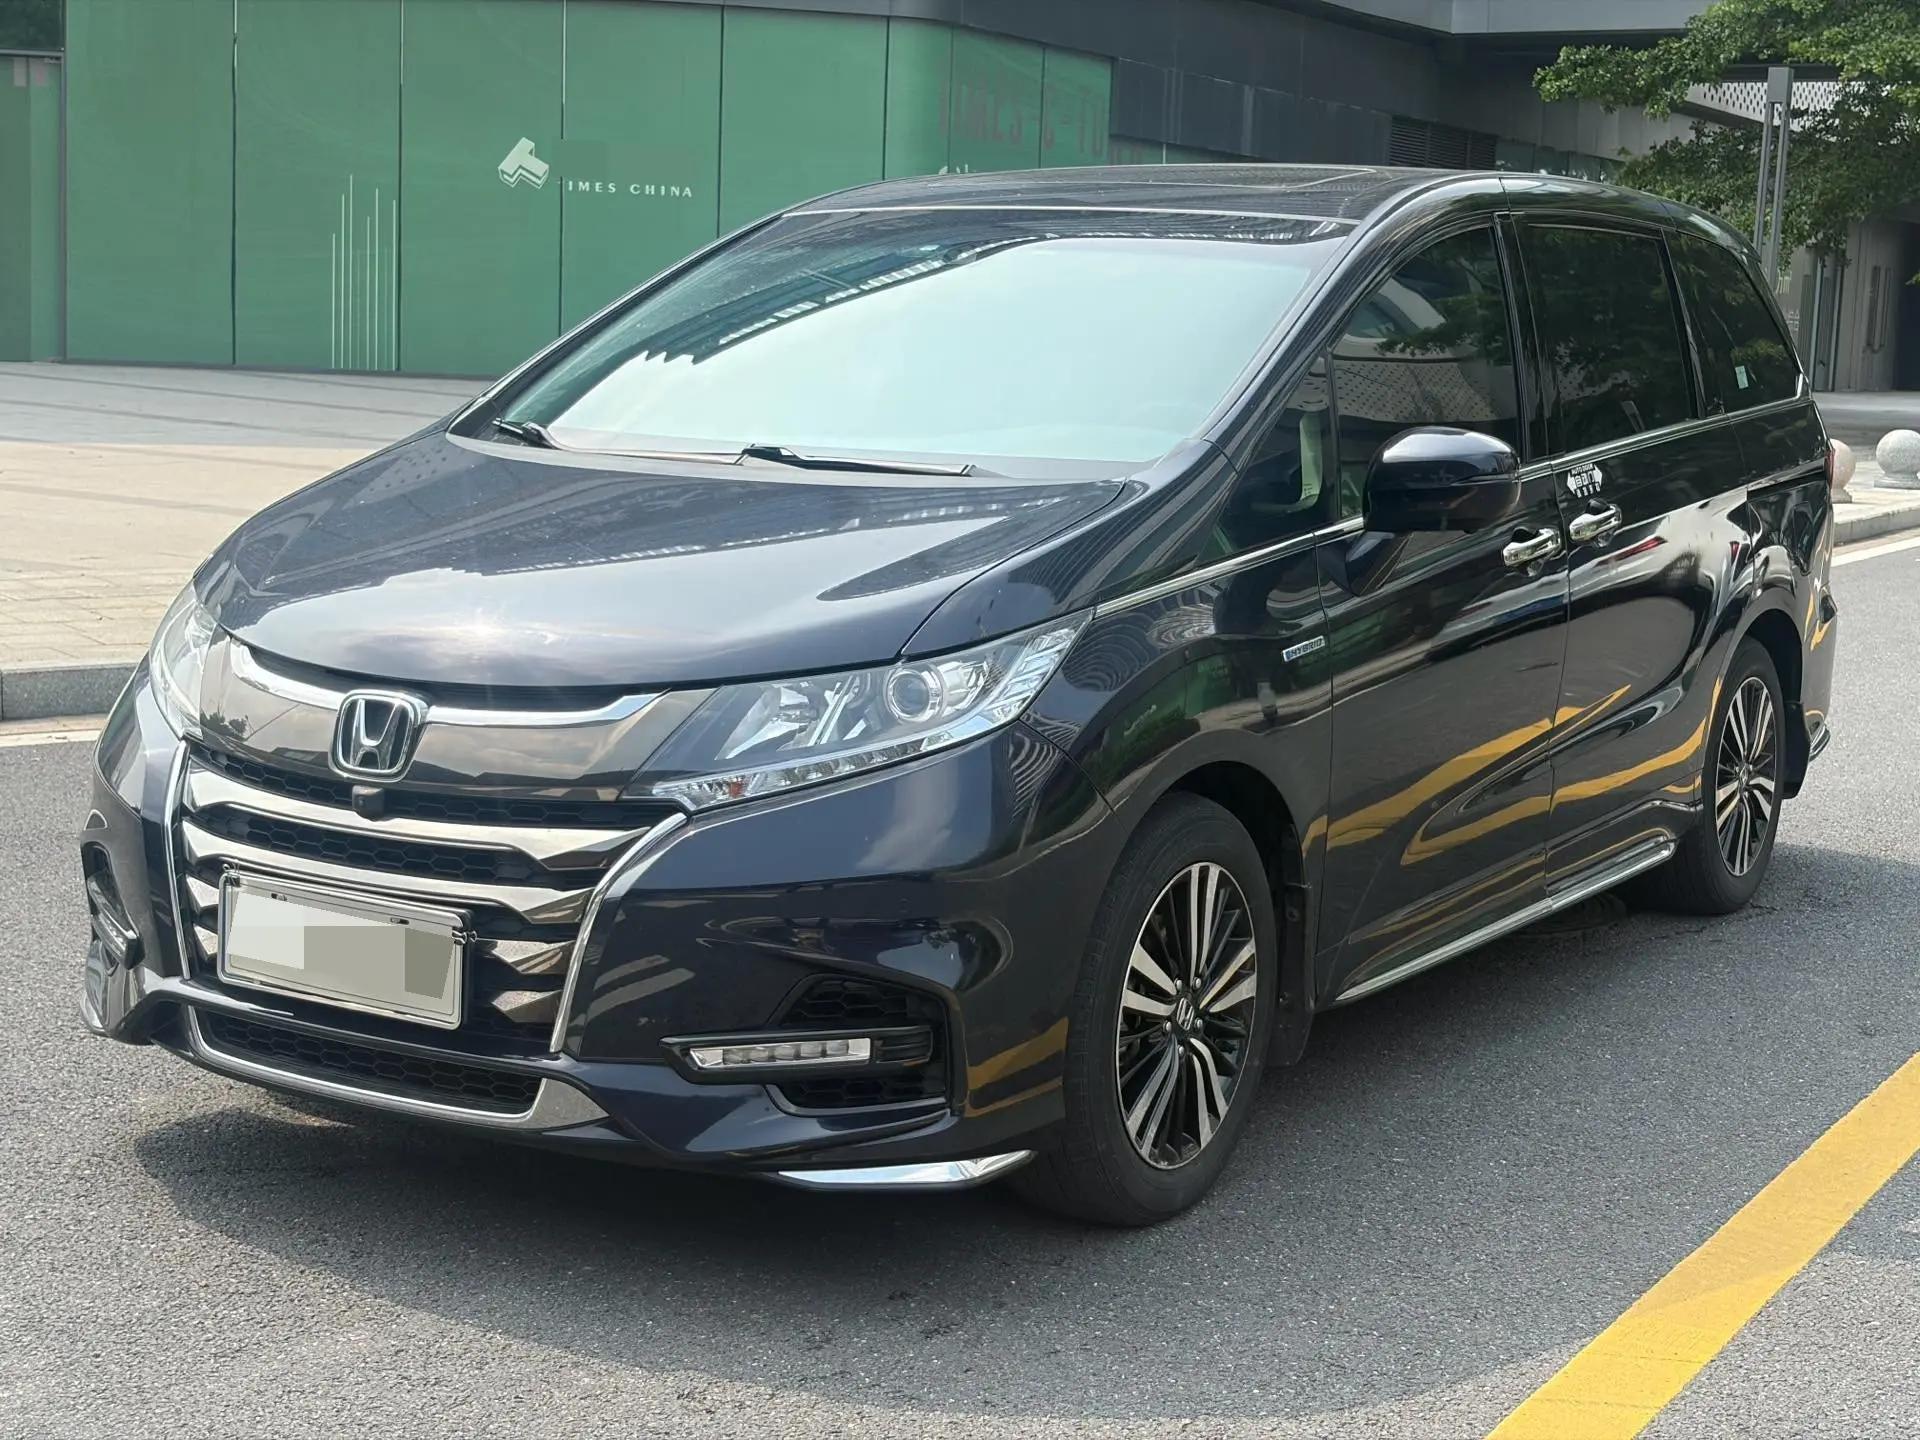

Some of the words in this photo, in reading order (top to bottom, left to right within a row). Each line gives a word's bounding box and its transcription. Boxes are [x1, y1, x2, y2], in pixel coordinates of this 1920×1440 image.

[557, 180, 616, 193] IMES
[629, 183, 692, 198] CHINA
[1291, 639, 1322, 657] HYBRID
